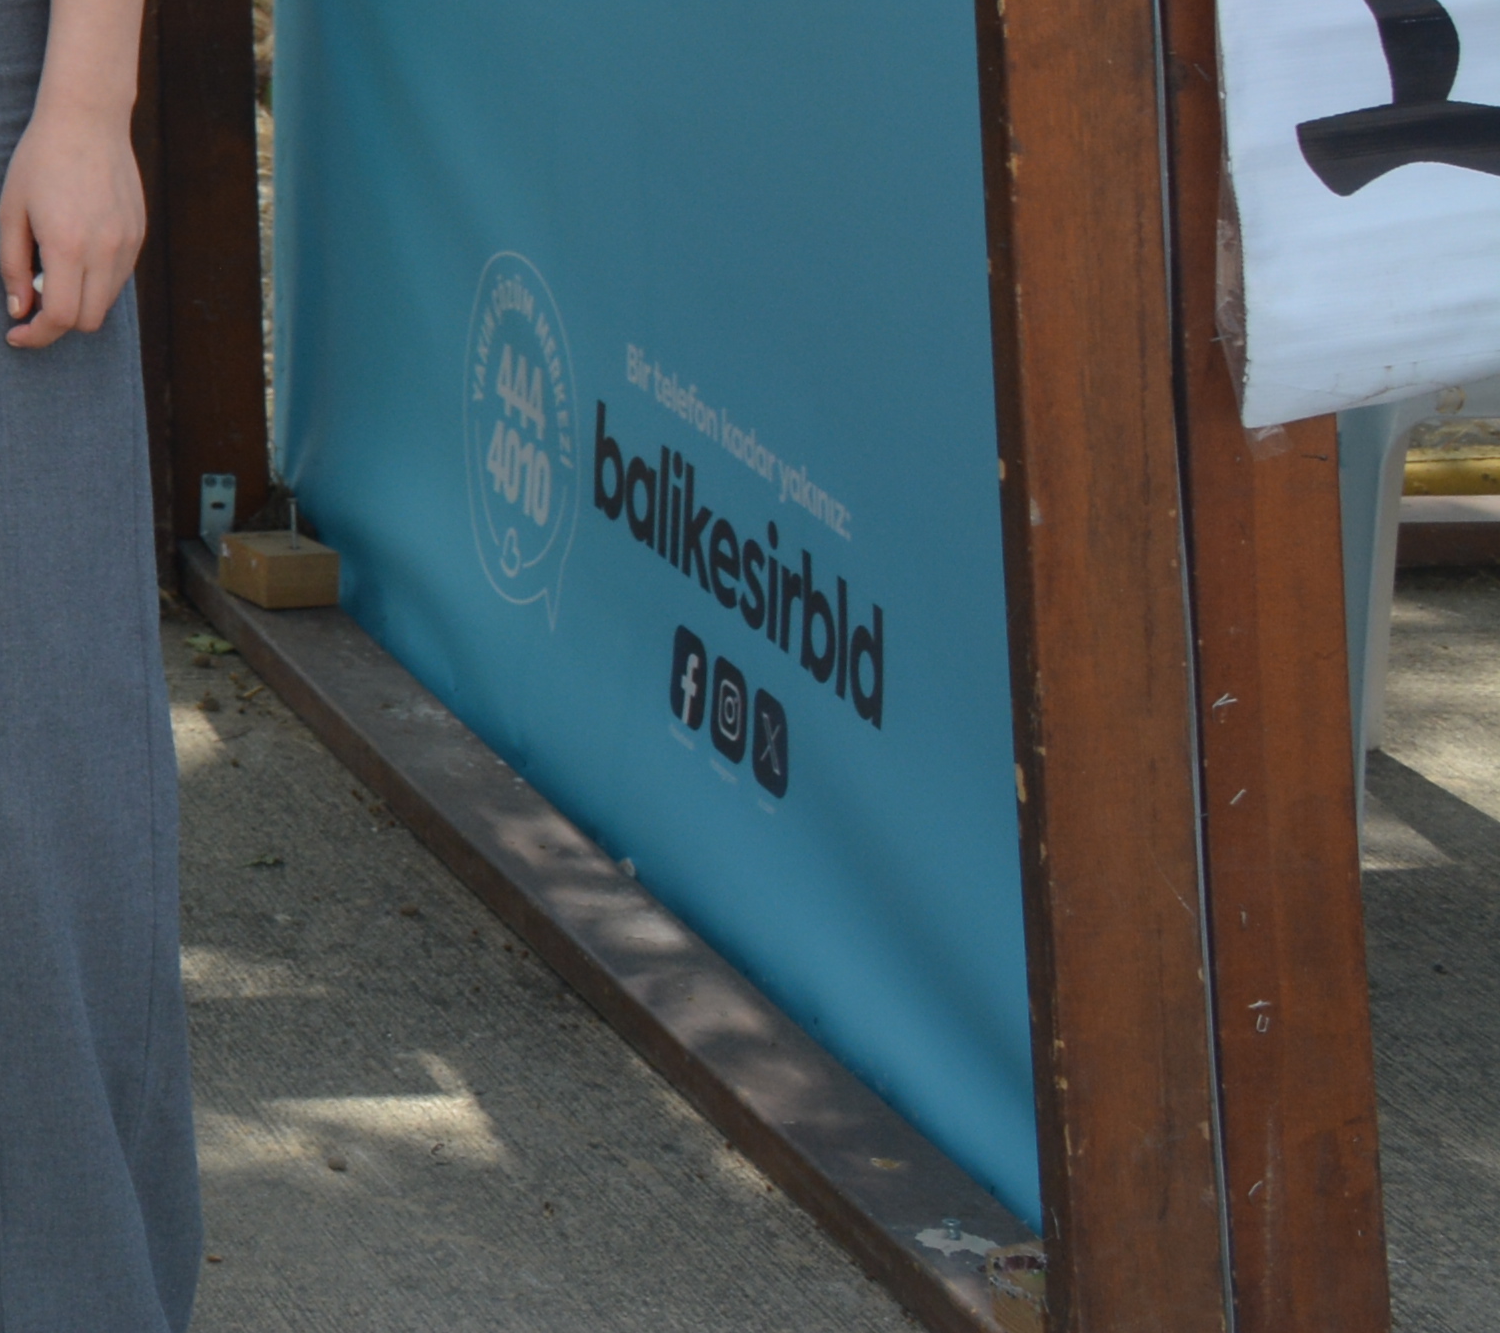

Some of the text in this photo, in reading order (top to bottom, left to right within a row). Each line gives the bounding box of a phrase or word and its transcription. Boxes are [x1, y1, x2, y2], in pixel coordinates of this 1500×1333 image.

[497, 343, 546, 442] 444
[626, 342, 650, 393] Bir
[653, 359, 719, 443] telefon
[487, 419, 551, 527] 4010
[594, 399, 885, 731] balikesirbld
